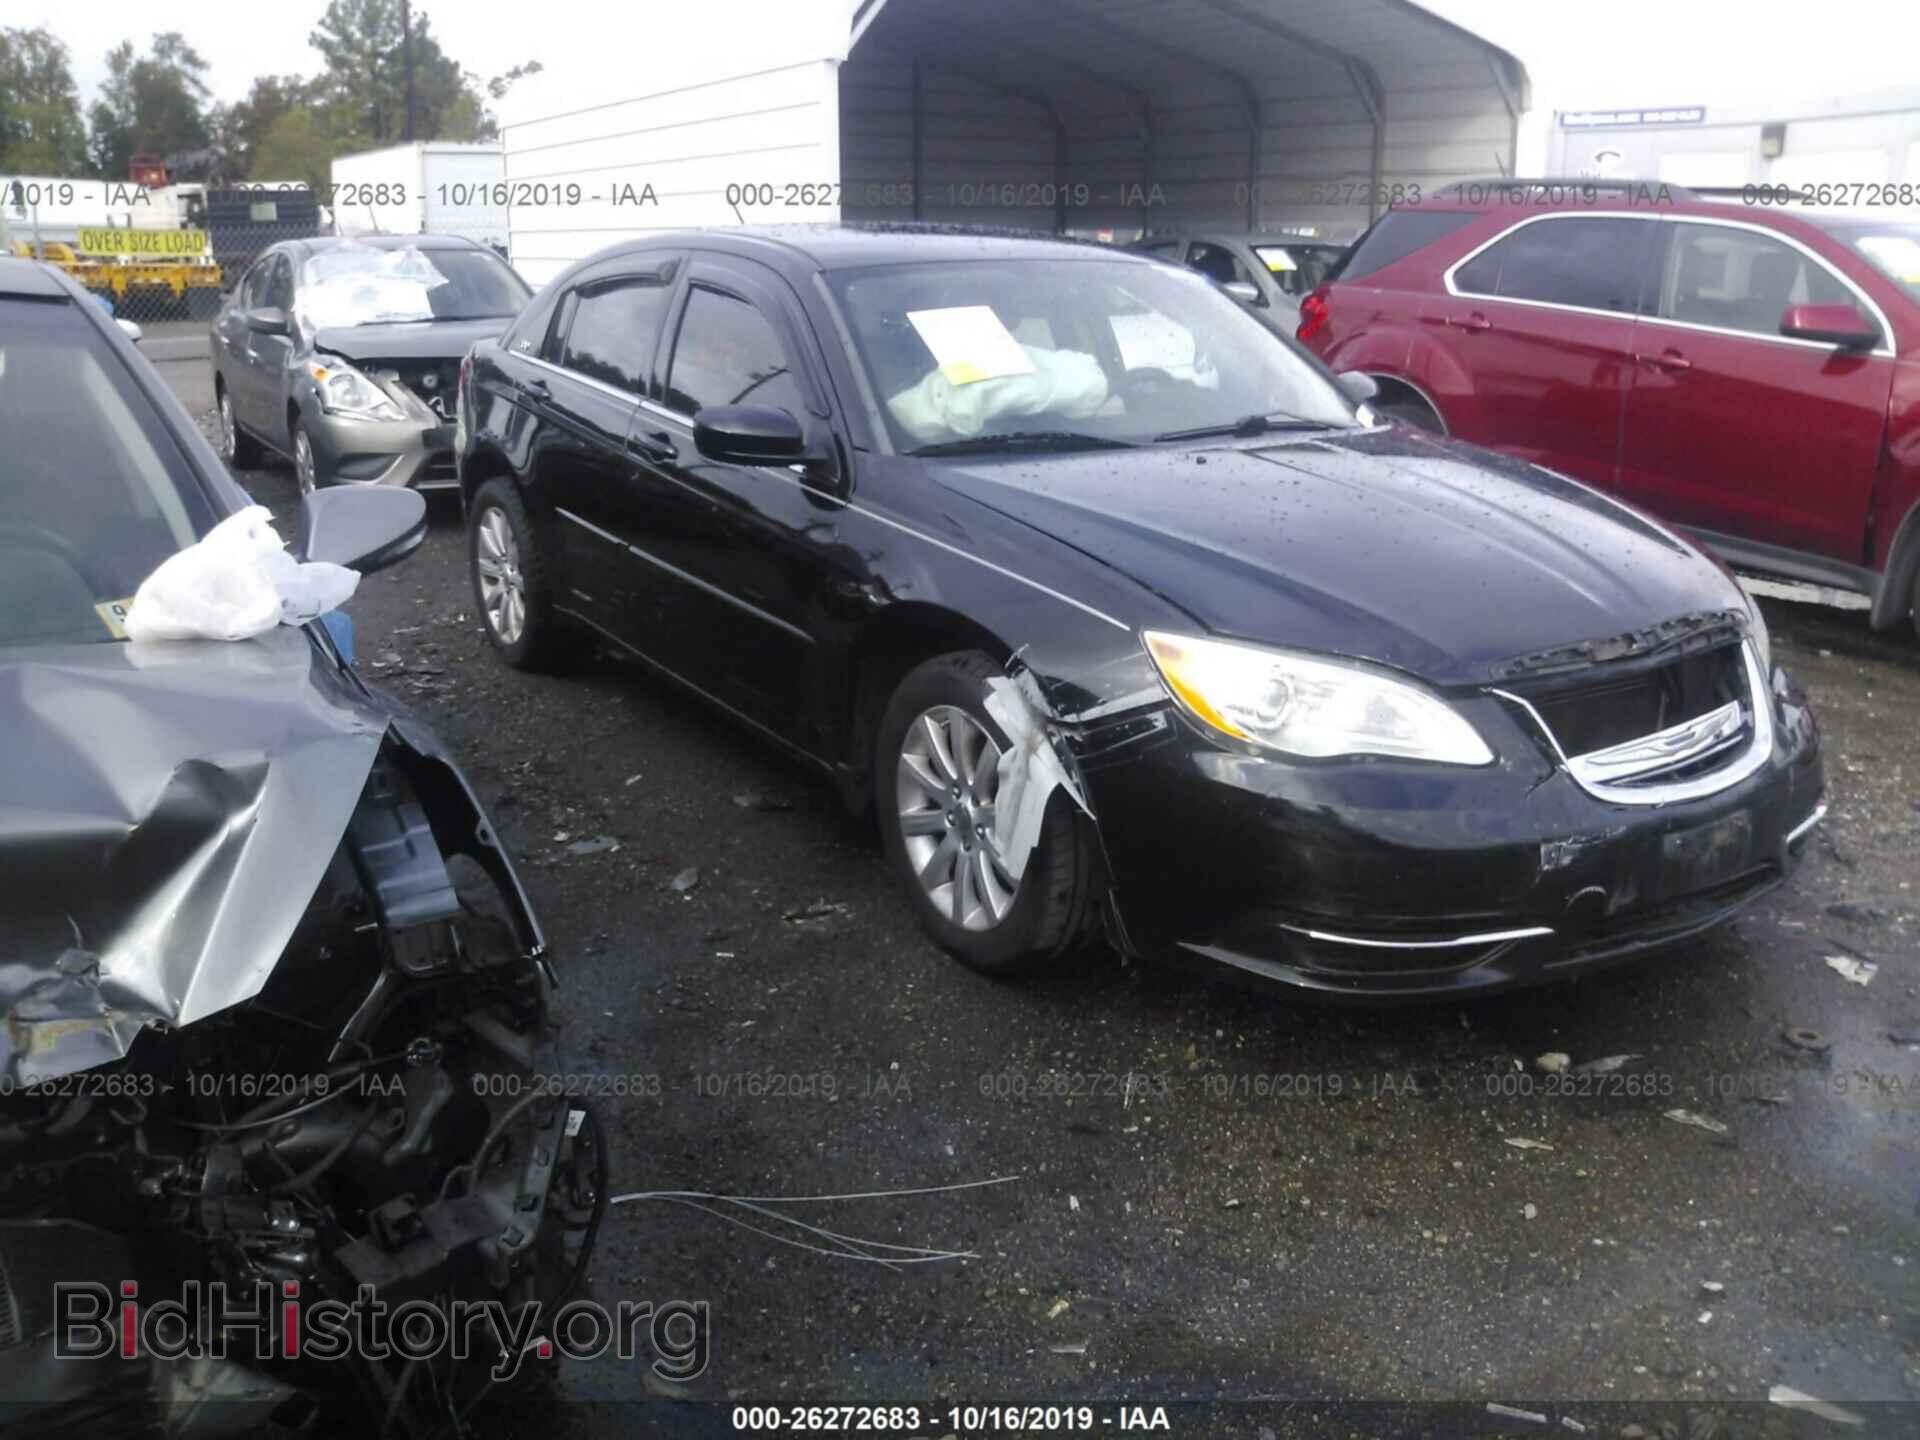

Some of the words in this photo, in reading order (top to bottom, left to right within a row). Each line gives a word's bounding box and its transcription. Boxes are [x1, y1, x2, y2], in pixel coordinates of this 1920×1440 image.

[82, 232, 125, 251] OVER
[129, 232, 157, 251] SIZE
[165, 230, 204, 251] LOAD
